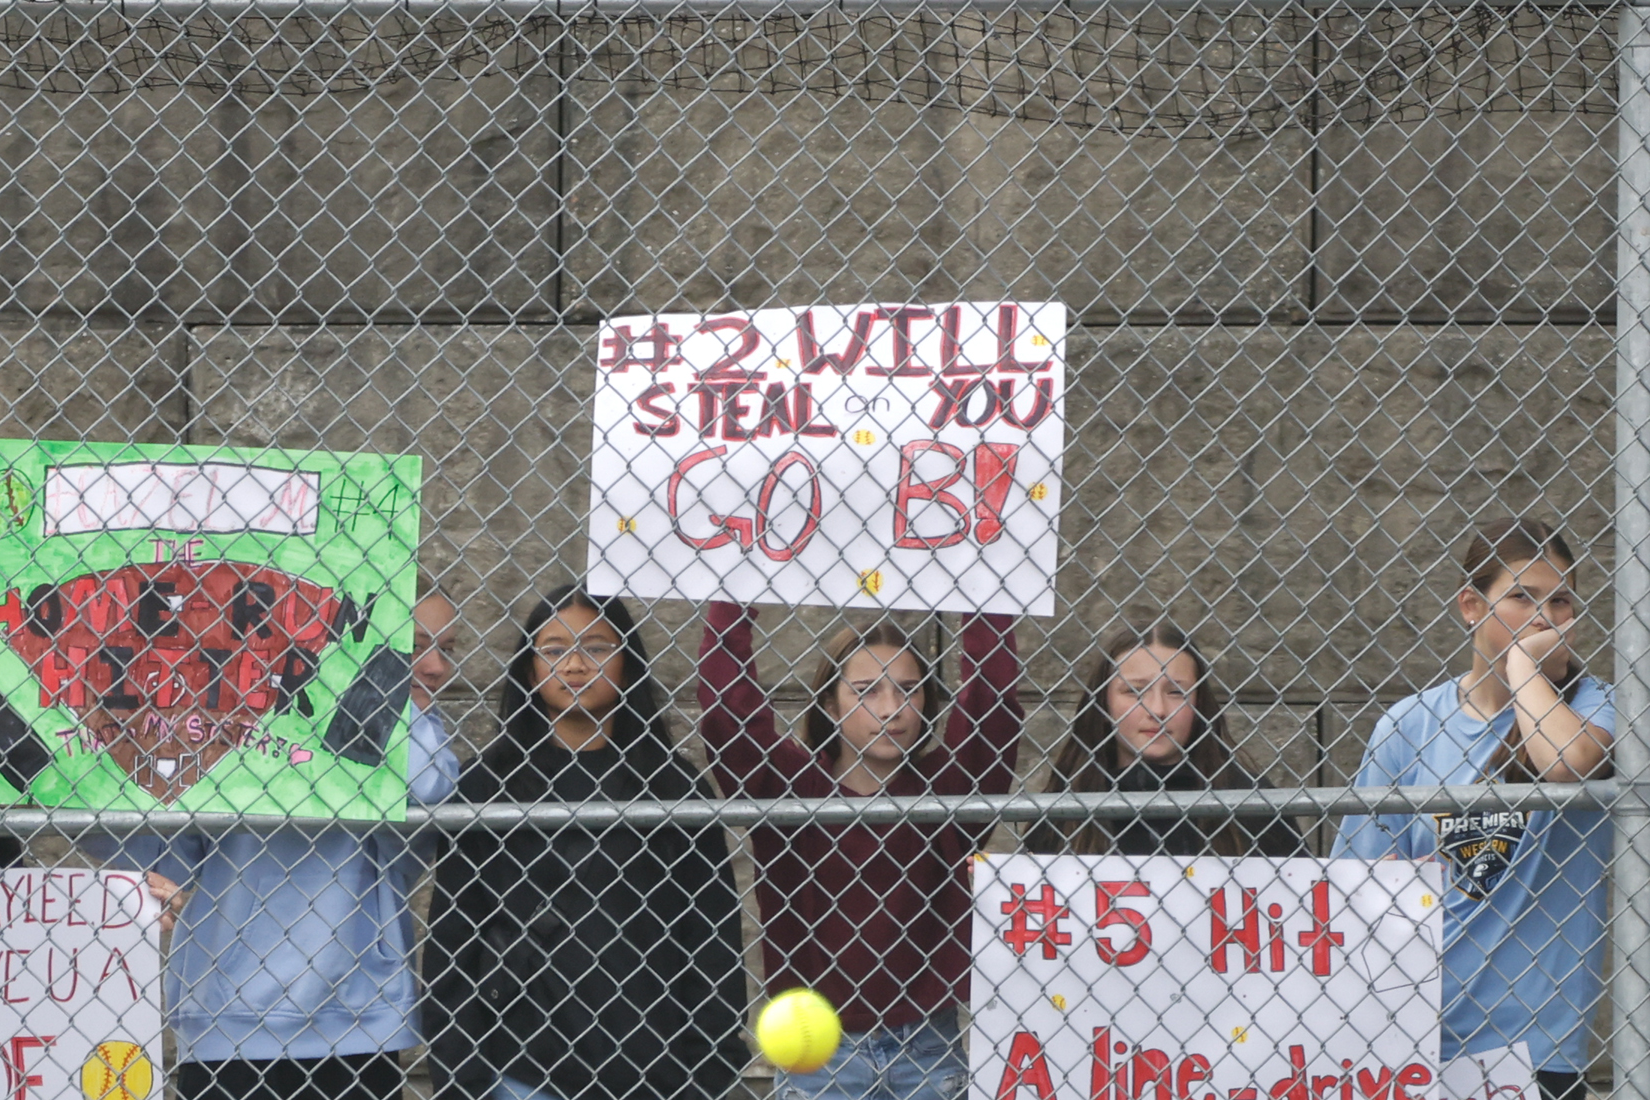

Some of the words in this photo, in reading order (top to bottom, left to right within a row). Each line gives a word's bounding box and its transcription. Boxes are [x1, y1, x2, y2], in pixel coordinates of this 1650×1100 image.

[600, 316, 767, 380] #2
[796, 305, 1053, 378] WILL
[634, 381, 838, 441] STEAL
[844, 394, 890, 415] on
[929, 377, 1054, 429] YOU
[46, 465, 236, 533] HAZEL
[330, 477, 400, 540] #4
[666, 444, 823, 562] GO
[148, 538, 204, 569] THE
[39, 645, 321, 718] HITTER
[143, 711, 179, 743] MY
[102, 874, 144, 930] D
[1000, 880, 1153, 968] #5
[1209, 880, 1344, 977] Hit
[48, 948, 78, 1002] U
[95, 947, 138, 1001] A
